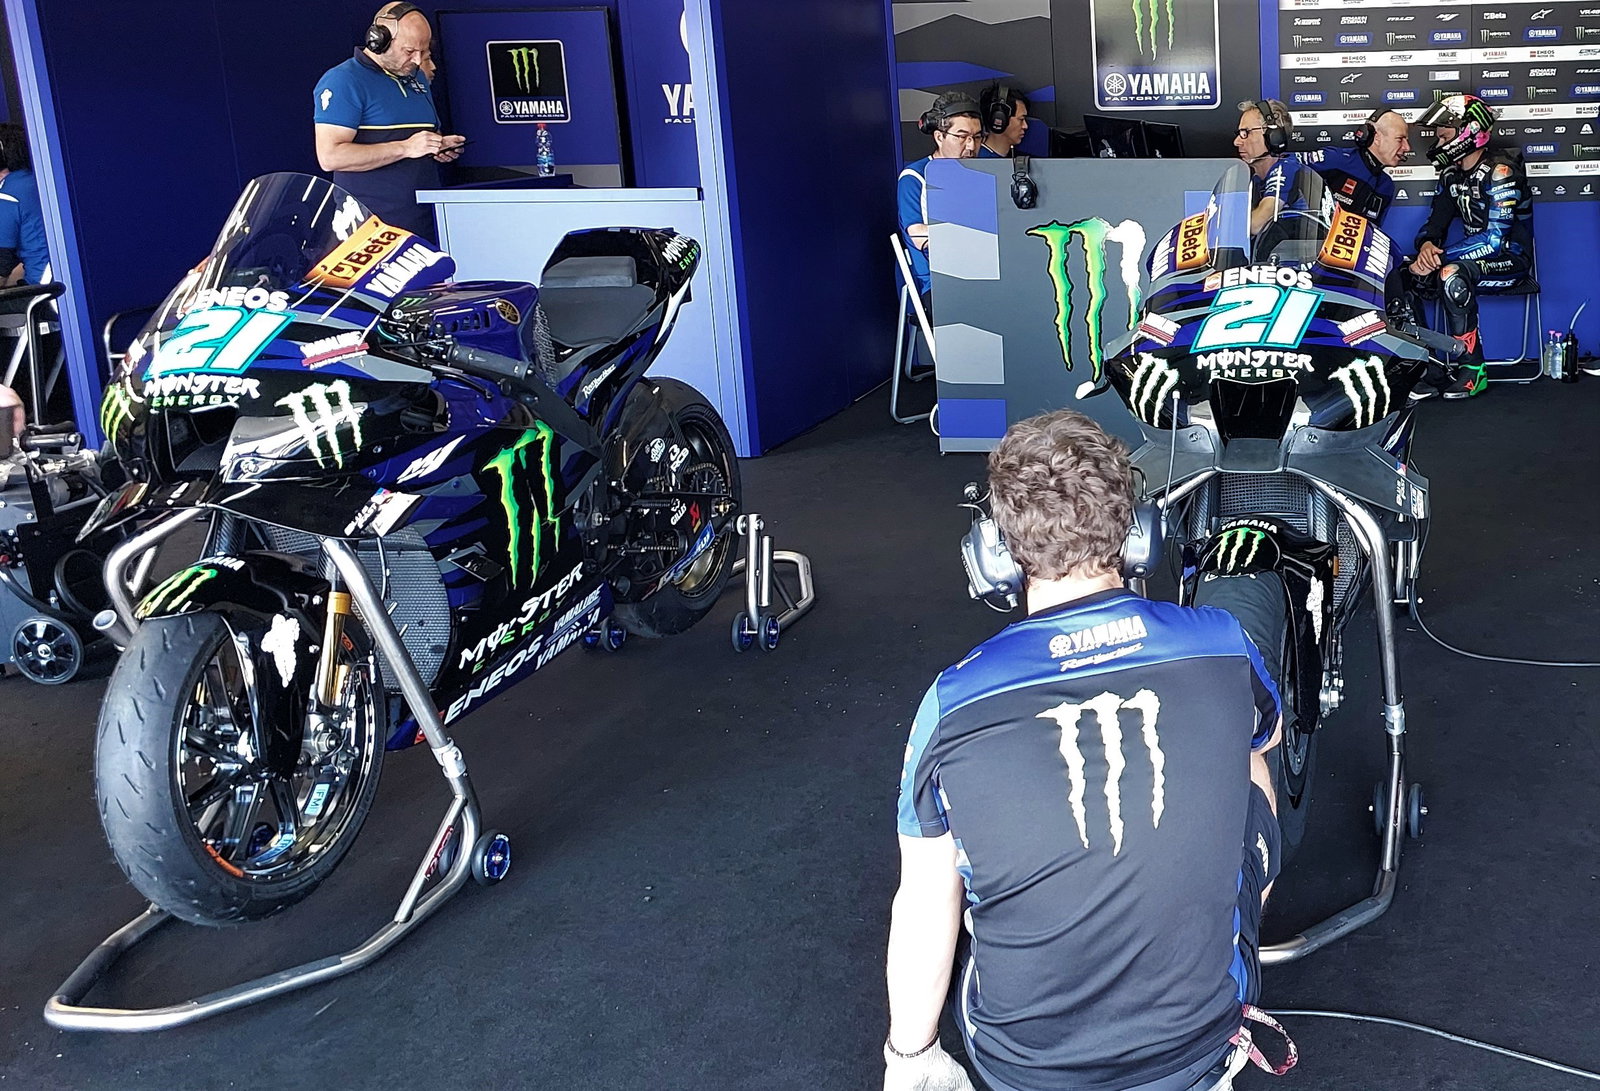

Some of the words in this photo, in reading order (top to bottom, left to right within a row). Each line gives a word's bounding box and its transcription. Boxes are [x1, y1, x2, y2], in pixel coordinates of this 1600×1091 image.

[1127, 72, 1211, 95] YAMAHA
[513, 100, 565, 114] YAMAHA
[1182, 226, 1203, 262] Beta
[1335, 215, 1361, 248] Beta
[344, 230, 401, 266] Beta
[1364, 227, 1391, 279] YAMAHA
[1459, 244, 1495, 260] YAMAHA
[365, 243, 440, 298] YAMAHA
[1221, 266, 1314, 290] ENEOS
[193, 286, 290, 311] ENEOS
[1190, 284, 1326, 353] 21
[141, 305, 297, 381] 21
[1196, 348, 1315, 372] MONSTER
[1210, 368, 1299, 379] ENERGY
[143, 371, 260, 399] MONSTER
[151, 395, 239, 407] ENERGY
[1221, 518, 1278, 534] YAMAHA
[552, 583, 604, 634] YAMALUBE
[1069, 615, 1148, 653] YAMAHA
[444, 634, 544, 725] ENEOS
